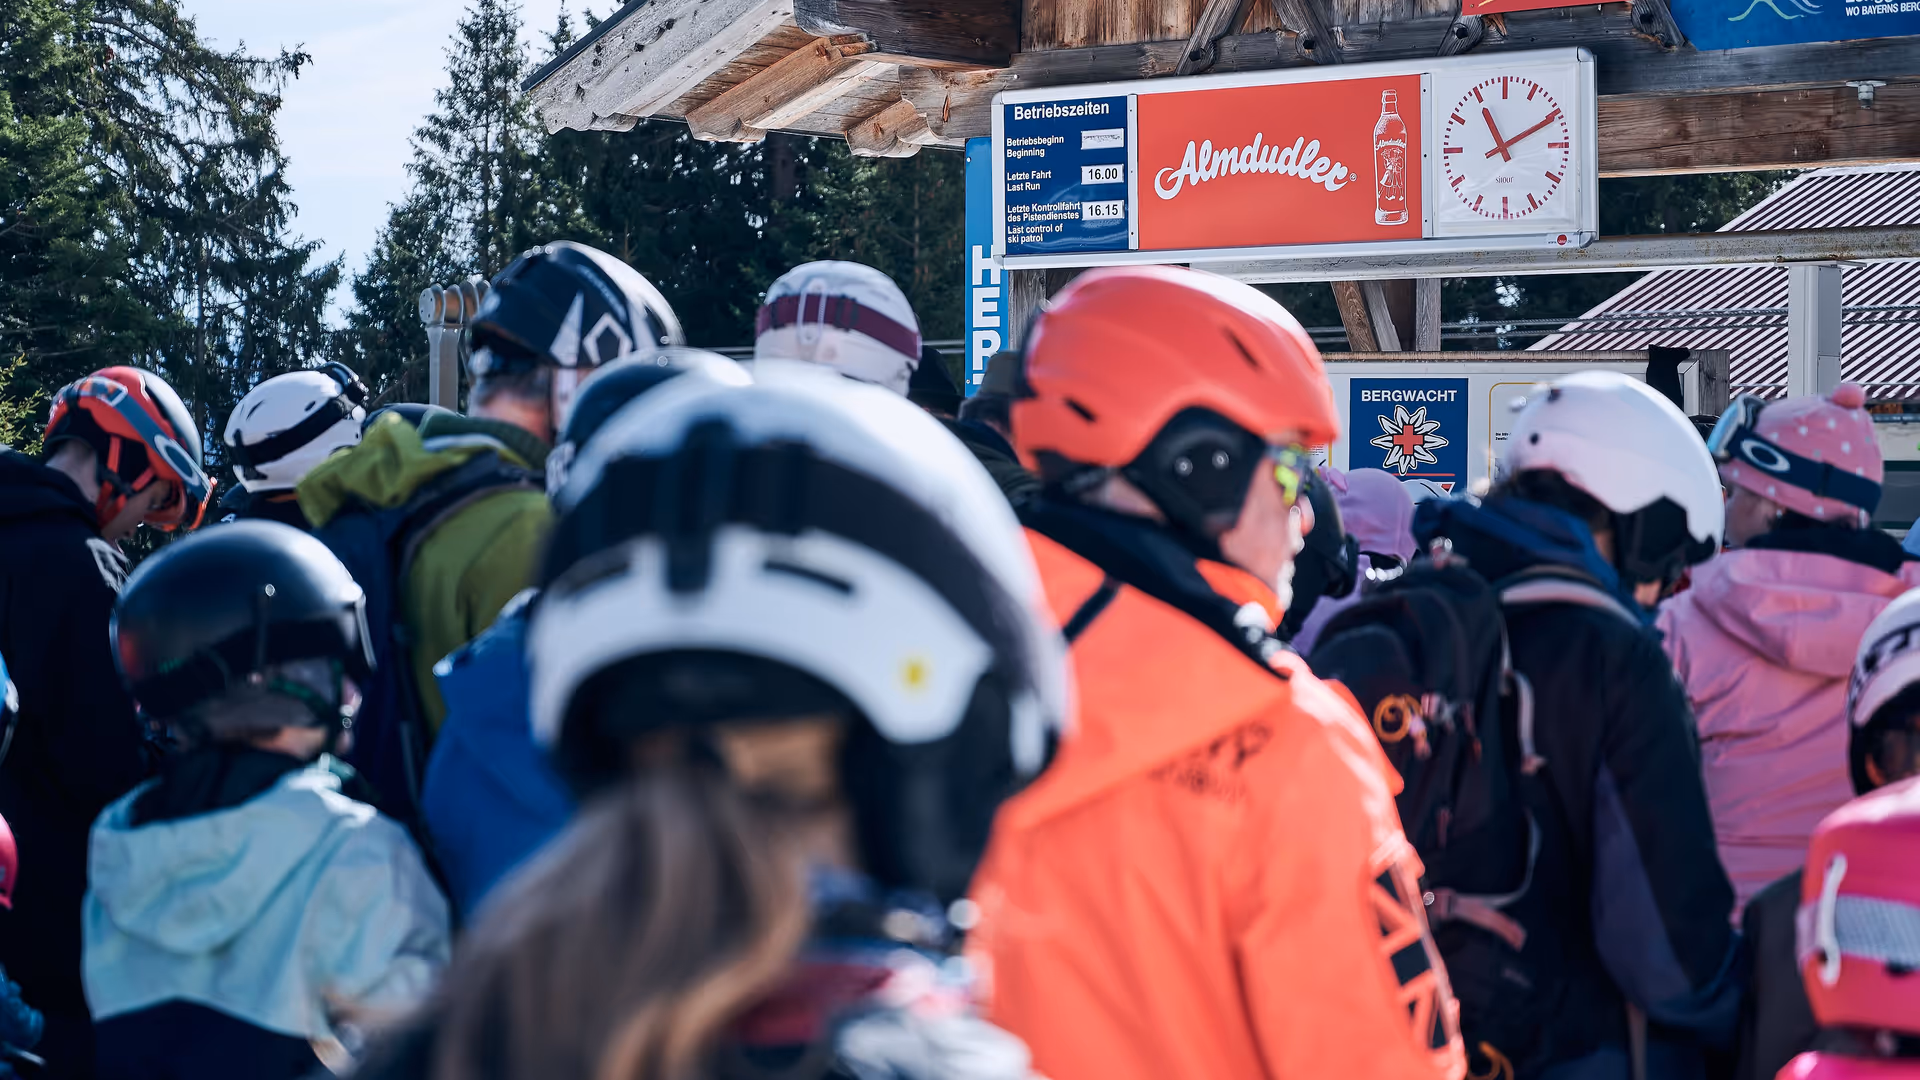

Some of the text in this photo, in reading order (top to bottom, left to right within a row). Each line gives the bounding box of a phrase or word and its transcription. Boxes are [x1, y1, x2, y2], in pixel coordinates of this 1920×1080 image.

[1845, 6, 1860, 17] WO
[1861, 3, 1899, 15] BAYERNS
[1014, 101, 1110, 121] Betriebszeiten
[1006, 135, 1064, 147] Betriebsbeginn
[1006, 147, 1045, 159] Beginning
[1154, 132, 1348, 200] Almdudler
[1007, 170, 1051, 181] Letzte Fahrt
[1088, 168, 1118, 180] 16.00
[1007, 182, 1041, 192] Last Run
[1007, 201, 1081, 214] Letzte Kontrollfahrt
[1088, 204, 1119, 216] 16.15
[1007, 211, 1080, 223] des Pistendienstes
[1007, 222, 1063, 235] Last control of
[1007, 233, 1043, 245] ski patrol
[972, 245, 1001, 385] HER
[1361, 389, 1458, 402] BERGWACHT
